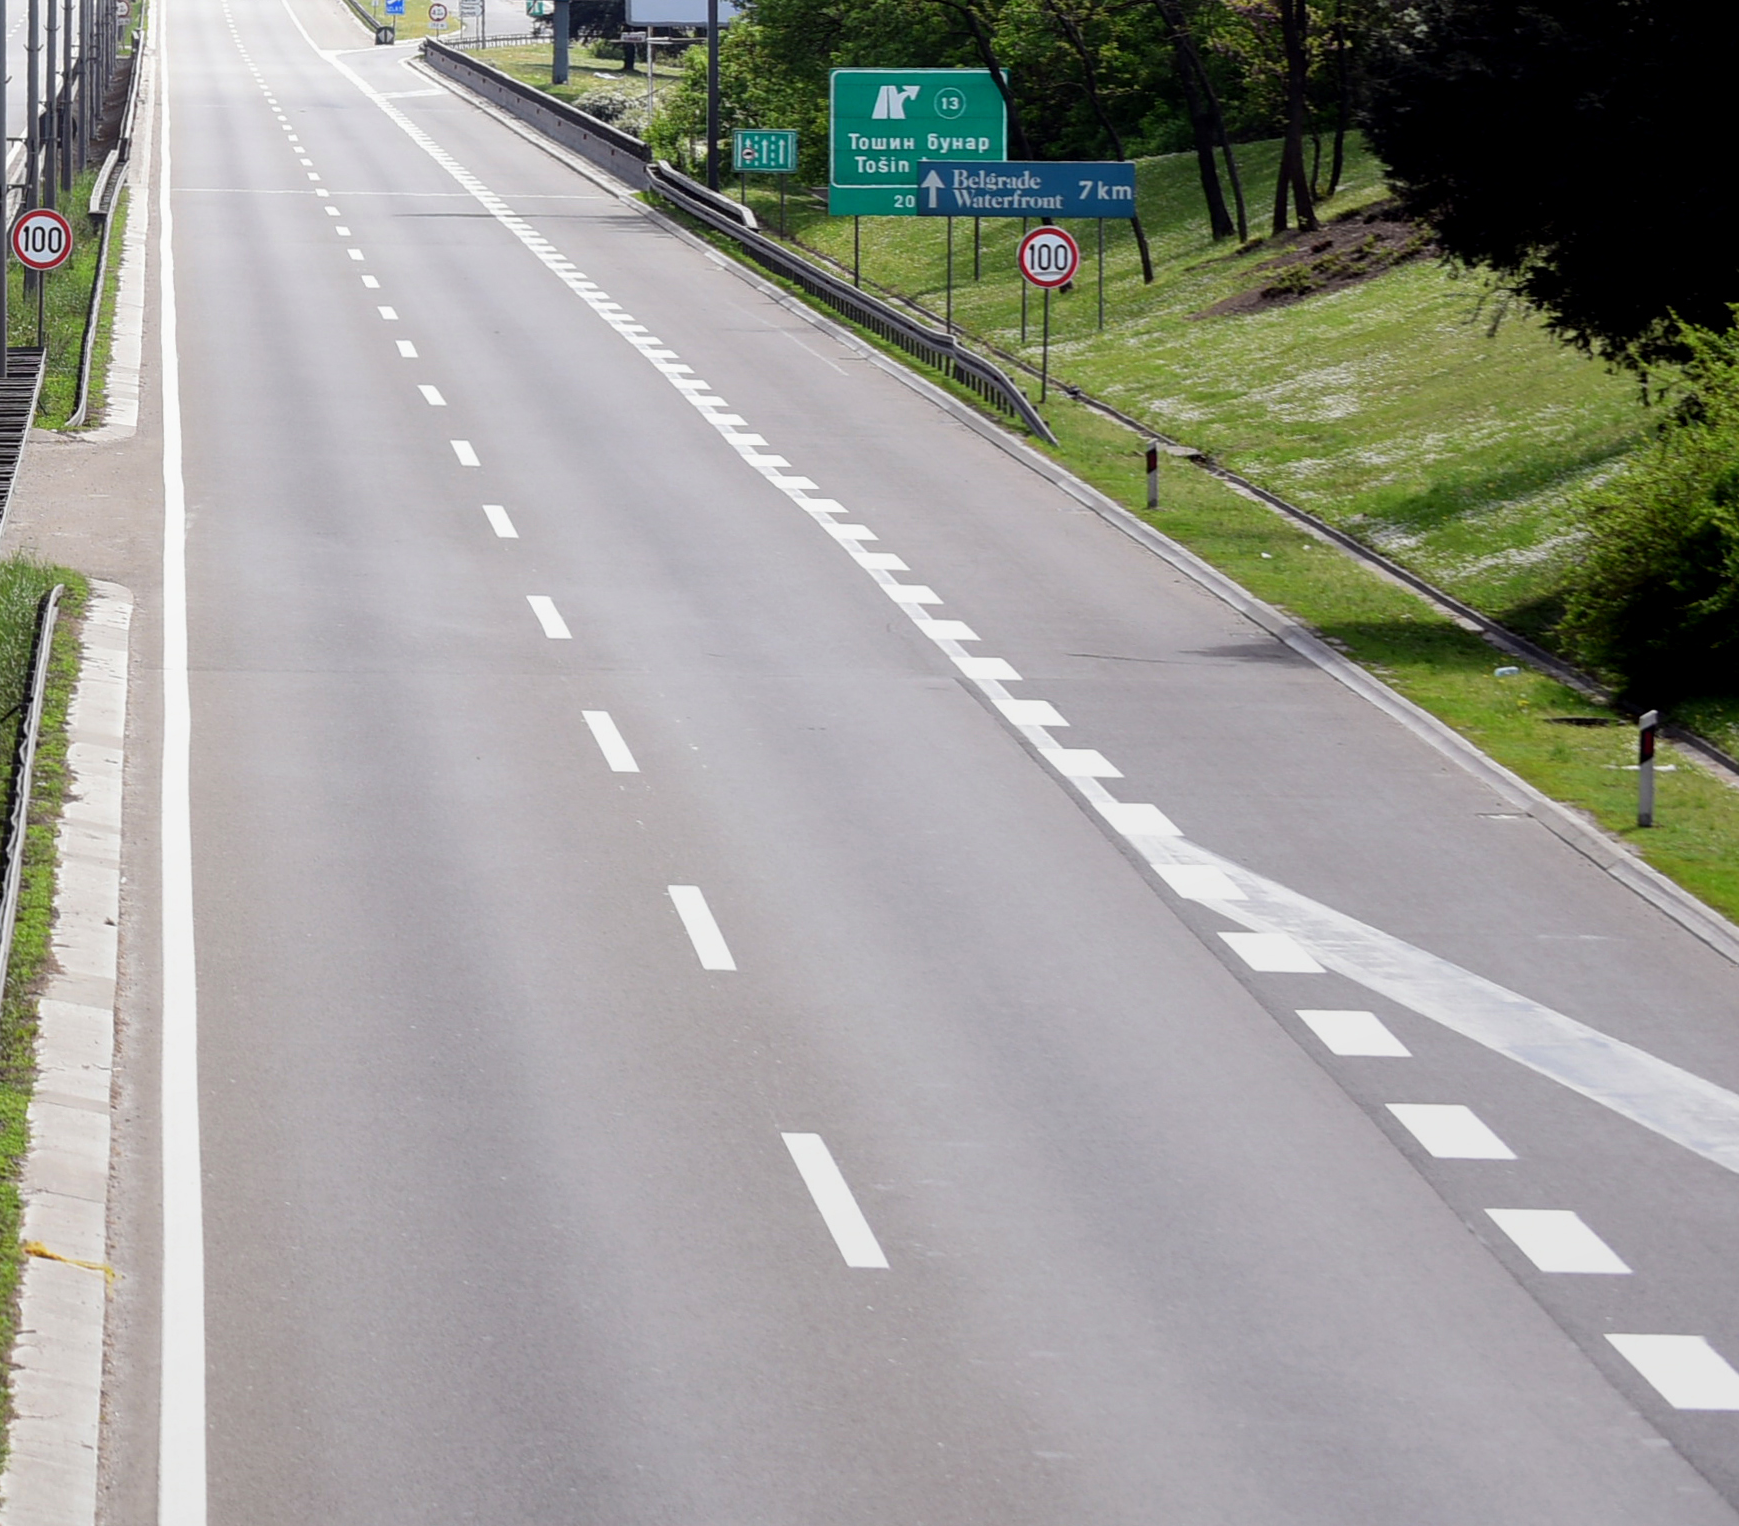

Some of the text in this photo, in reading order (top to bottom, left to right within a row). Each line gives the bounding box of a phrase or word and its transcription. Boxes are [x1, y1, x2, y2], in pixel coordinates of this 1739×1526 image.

[941, 97, 960, 110] 13
[848, 133, 990, 153] Тошин бунар
[854, 156, 910, 173] Tošin
[952, 169, 1042, 191] Belgrade
[1079, 179, 1132, 201] 7 km
[953, 188, 1064, 210] Waterfront
[23, 225, 62, 254] 100
[1028, 243, 1069, 271] 100
